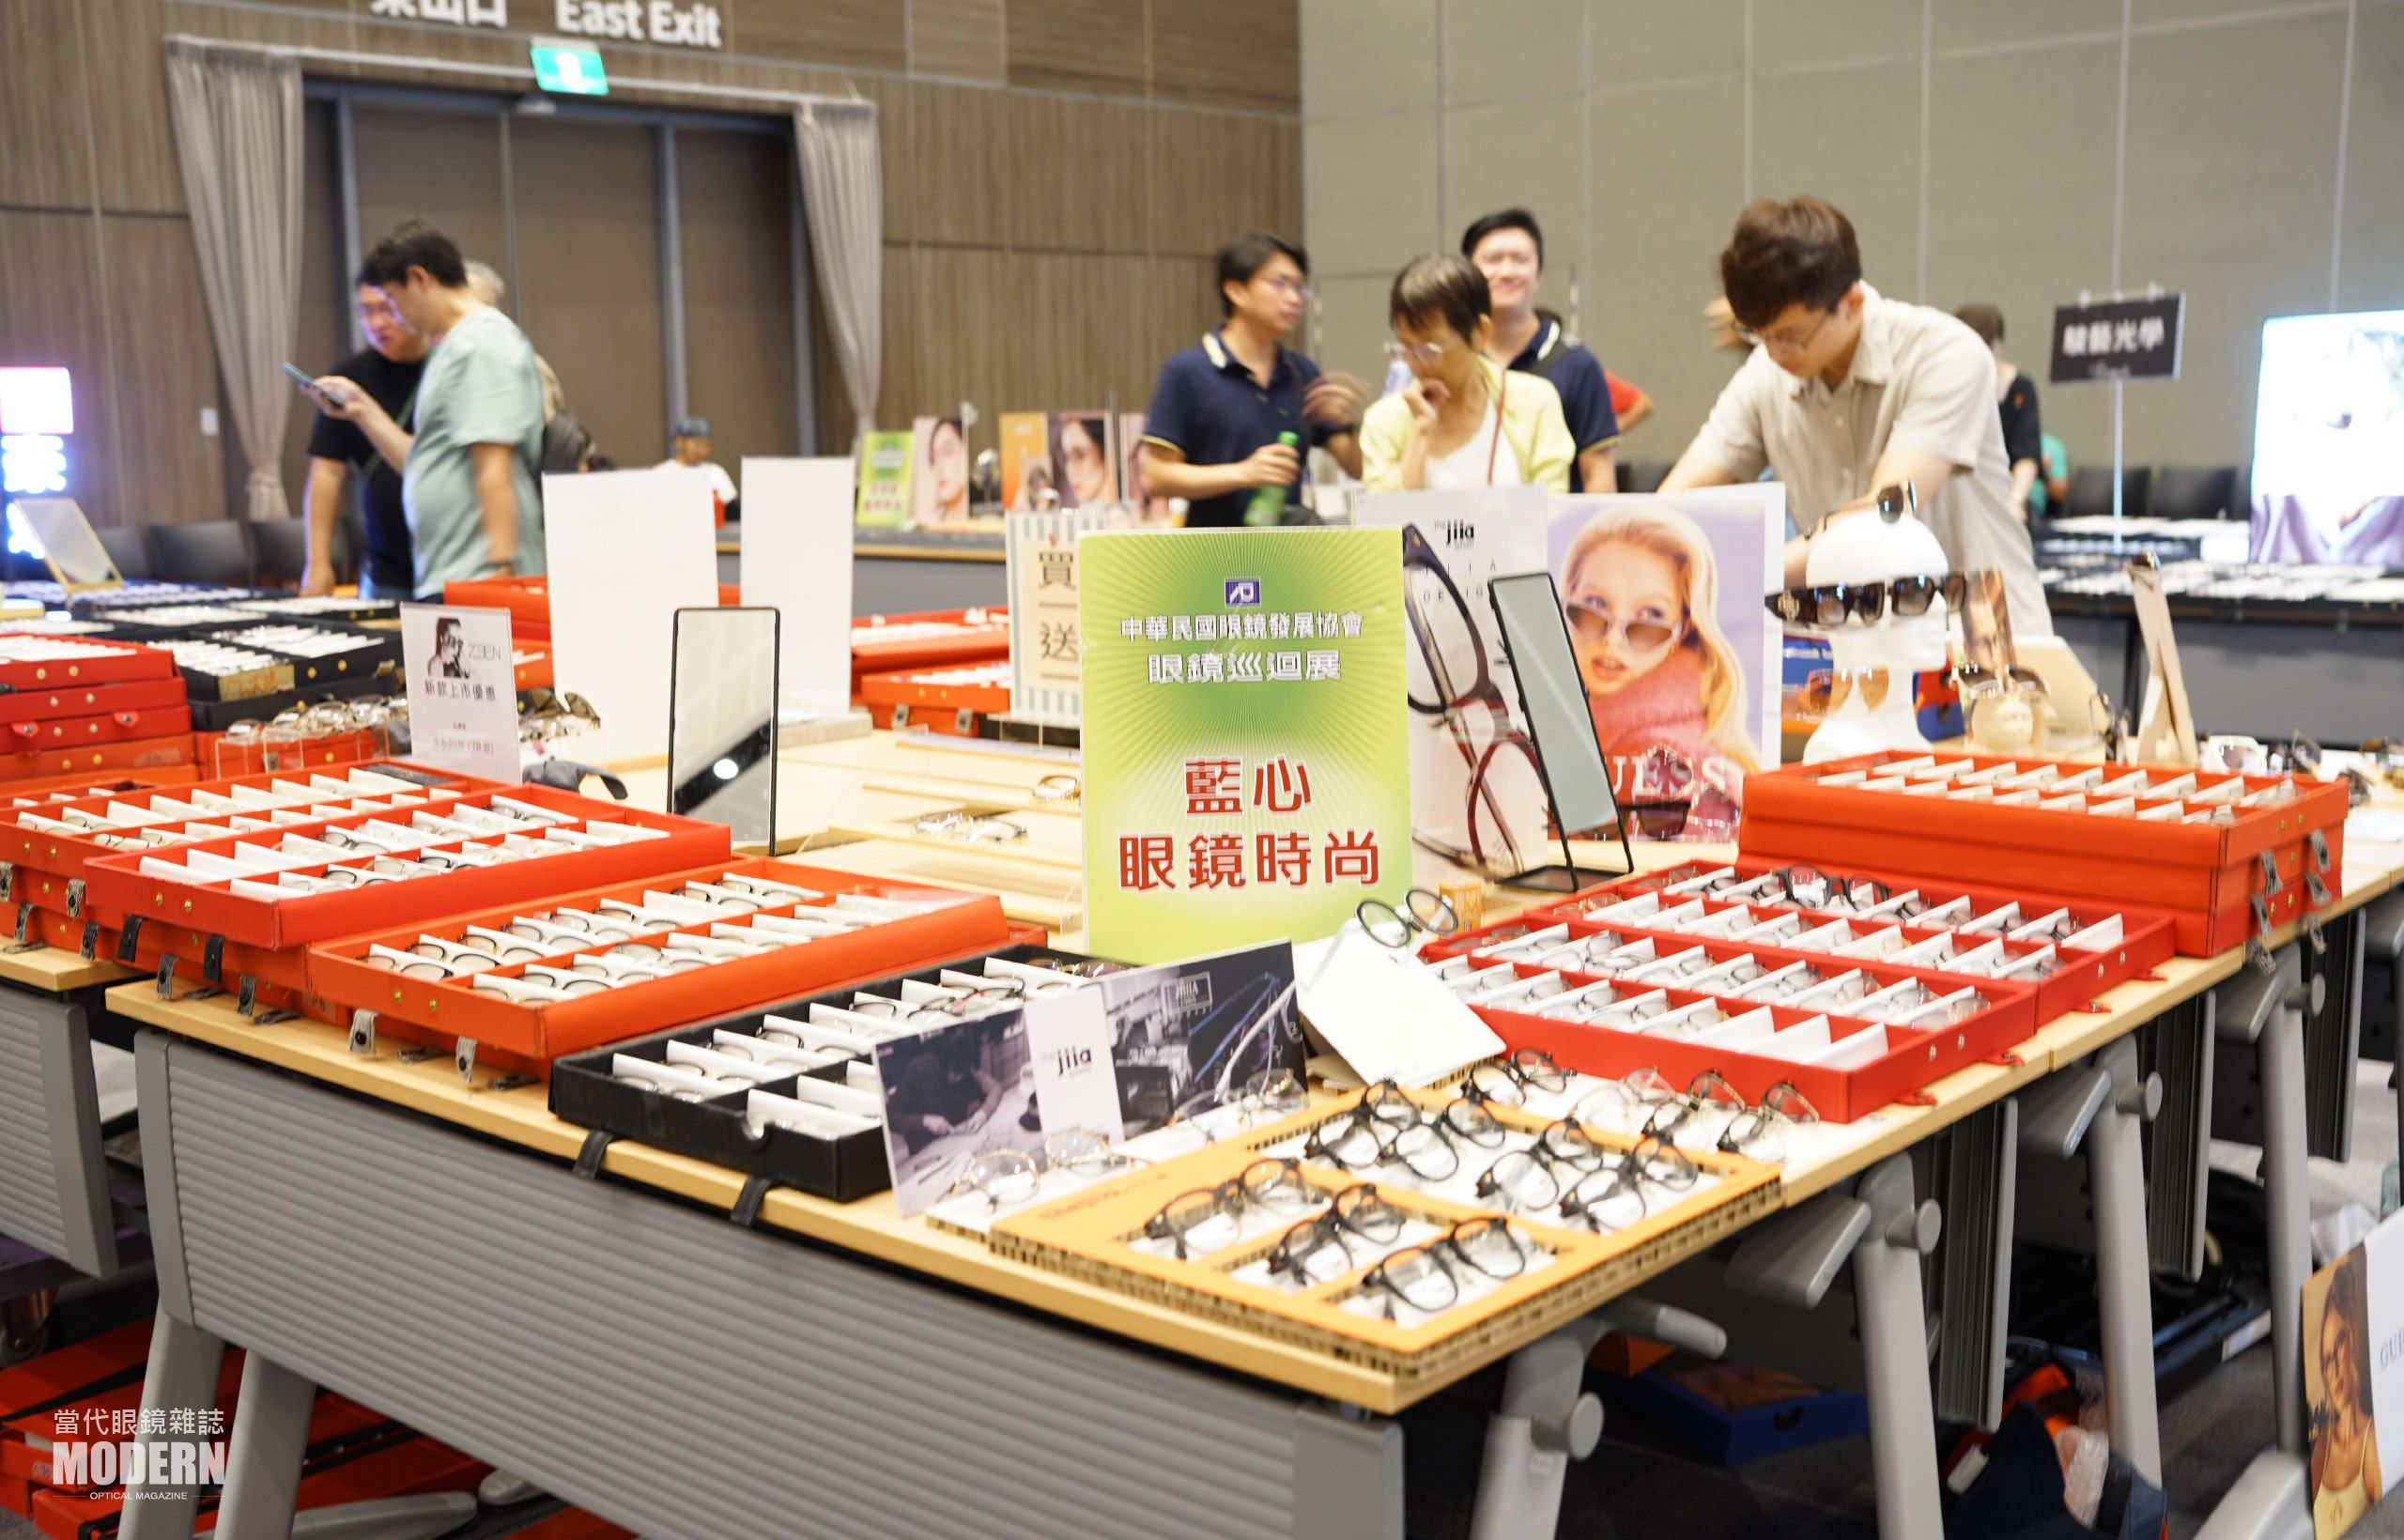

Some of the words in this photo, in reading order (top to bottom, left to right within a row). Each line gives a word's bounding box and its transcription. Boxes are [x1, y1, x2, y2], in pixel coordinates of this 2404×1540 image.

[555, 0, 644, 39] East
[649, 0, 721, 48] Exit
[1038, 551, 1079, 682] 買一送一
[1120, 610, 1364, 643] 中華民國眼鏡發展協會
[1147, 649, 1342, 685] 眼鏡巡迴展
[1183, 754, 1312, 817] 藍心
[1118, 828, 1381, 893] 眼鏡時尚
